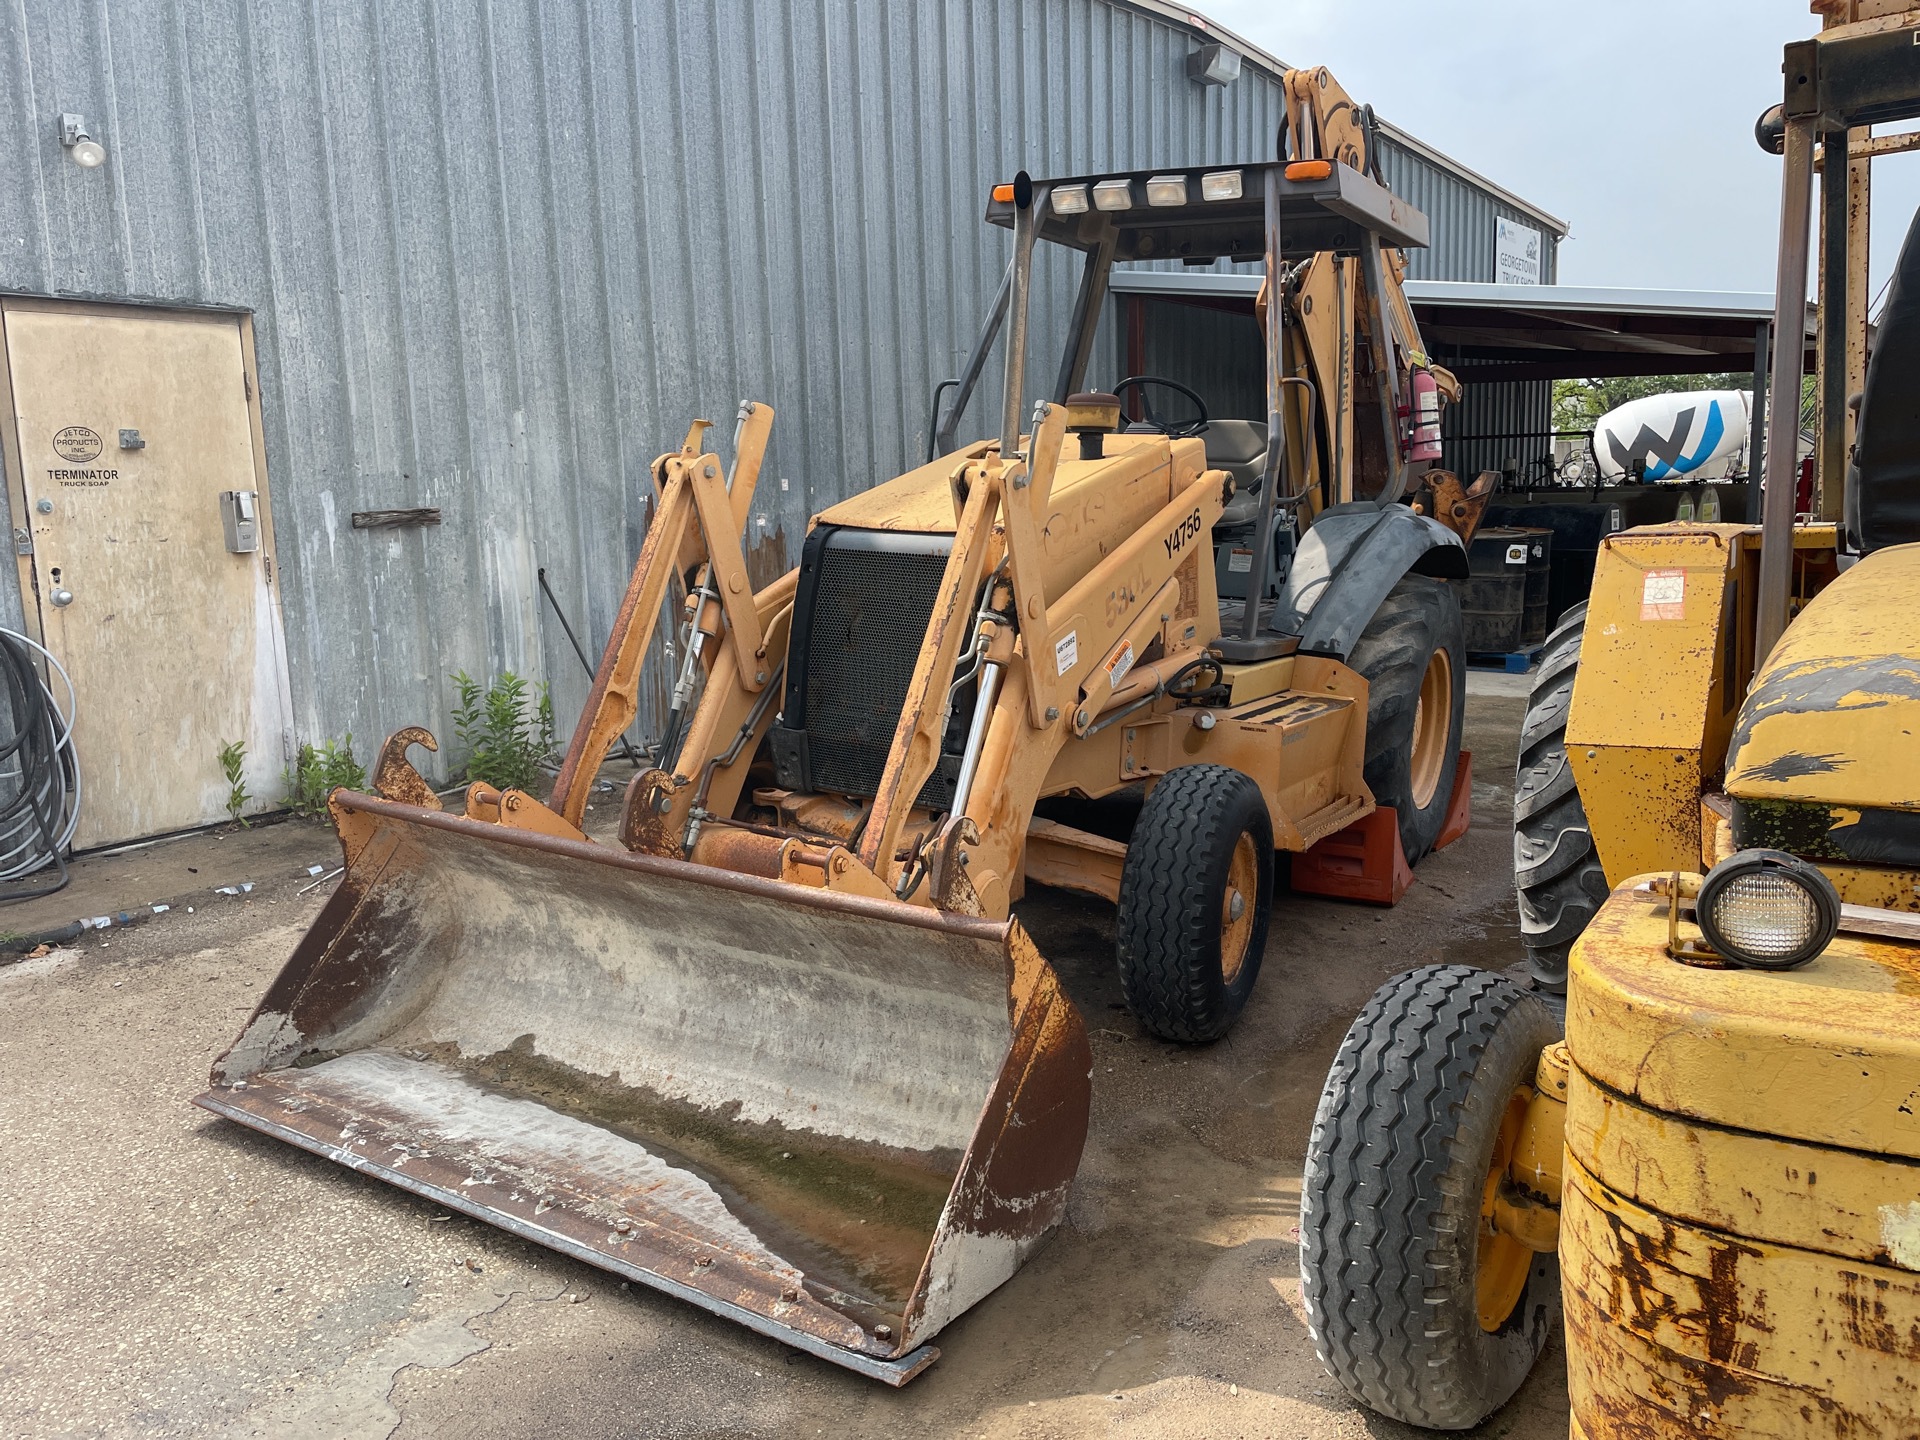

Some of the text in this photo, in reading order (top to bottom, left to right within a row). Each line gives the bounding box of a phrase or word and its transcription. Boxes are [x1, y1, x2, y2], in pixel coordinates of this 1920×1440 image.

[1501, 252, 1538, 276] GEORGETOWN
[1503, 271, 1520, 285] TRUCK
[63, 429, 91, 438] JETCO
[47, 470, 119, 480] TERMINATOR
[1164, 507, 1201, 560] Y4756
